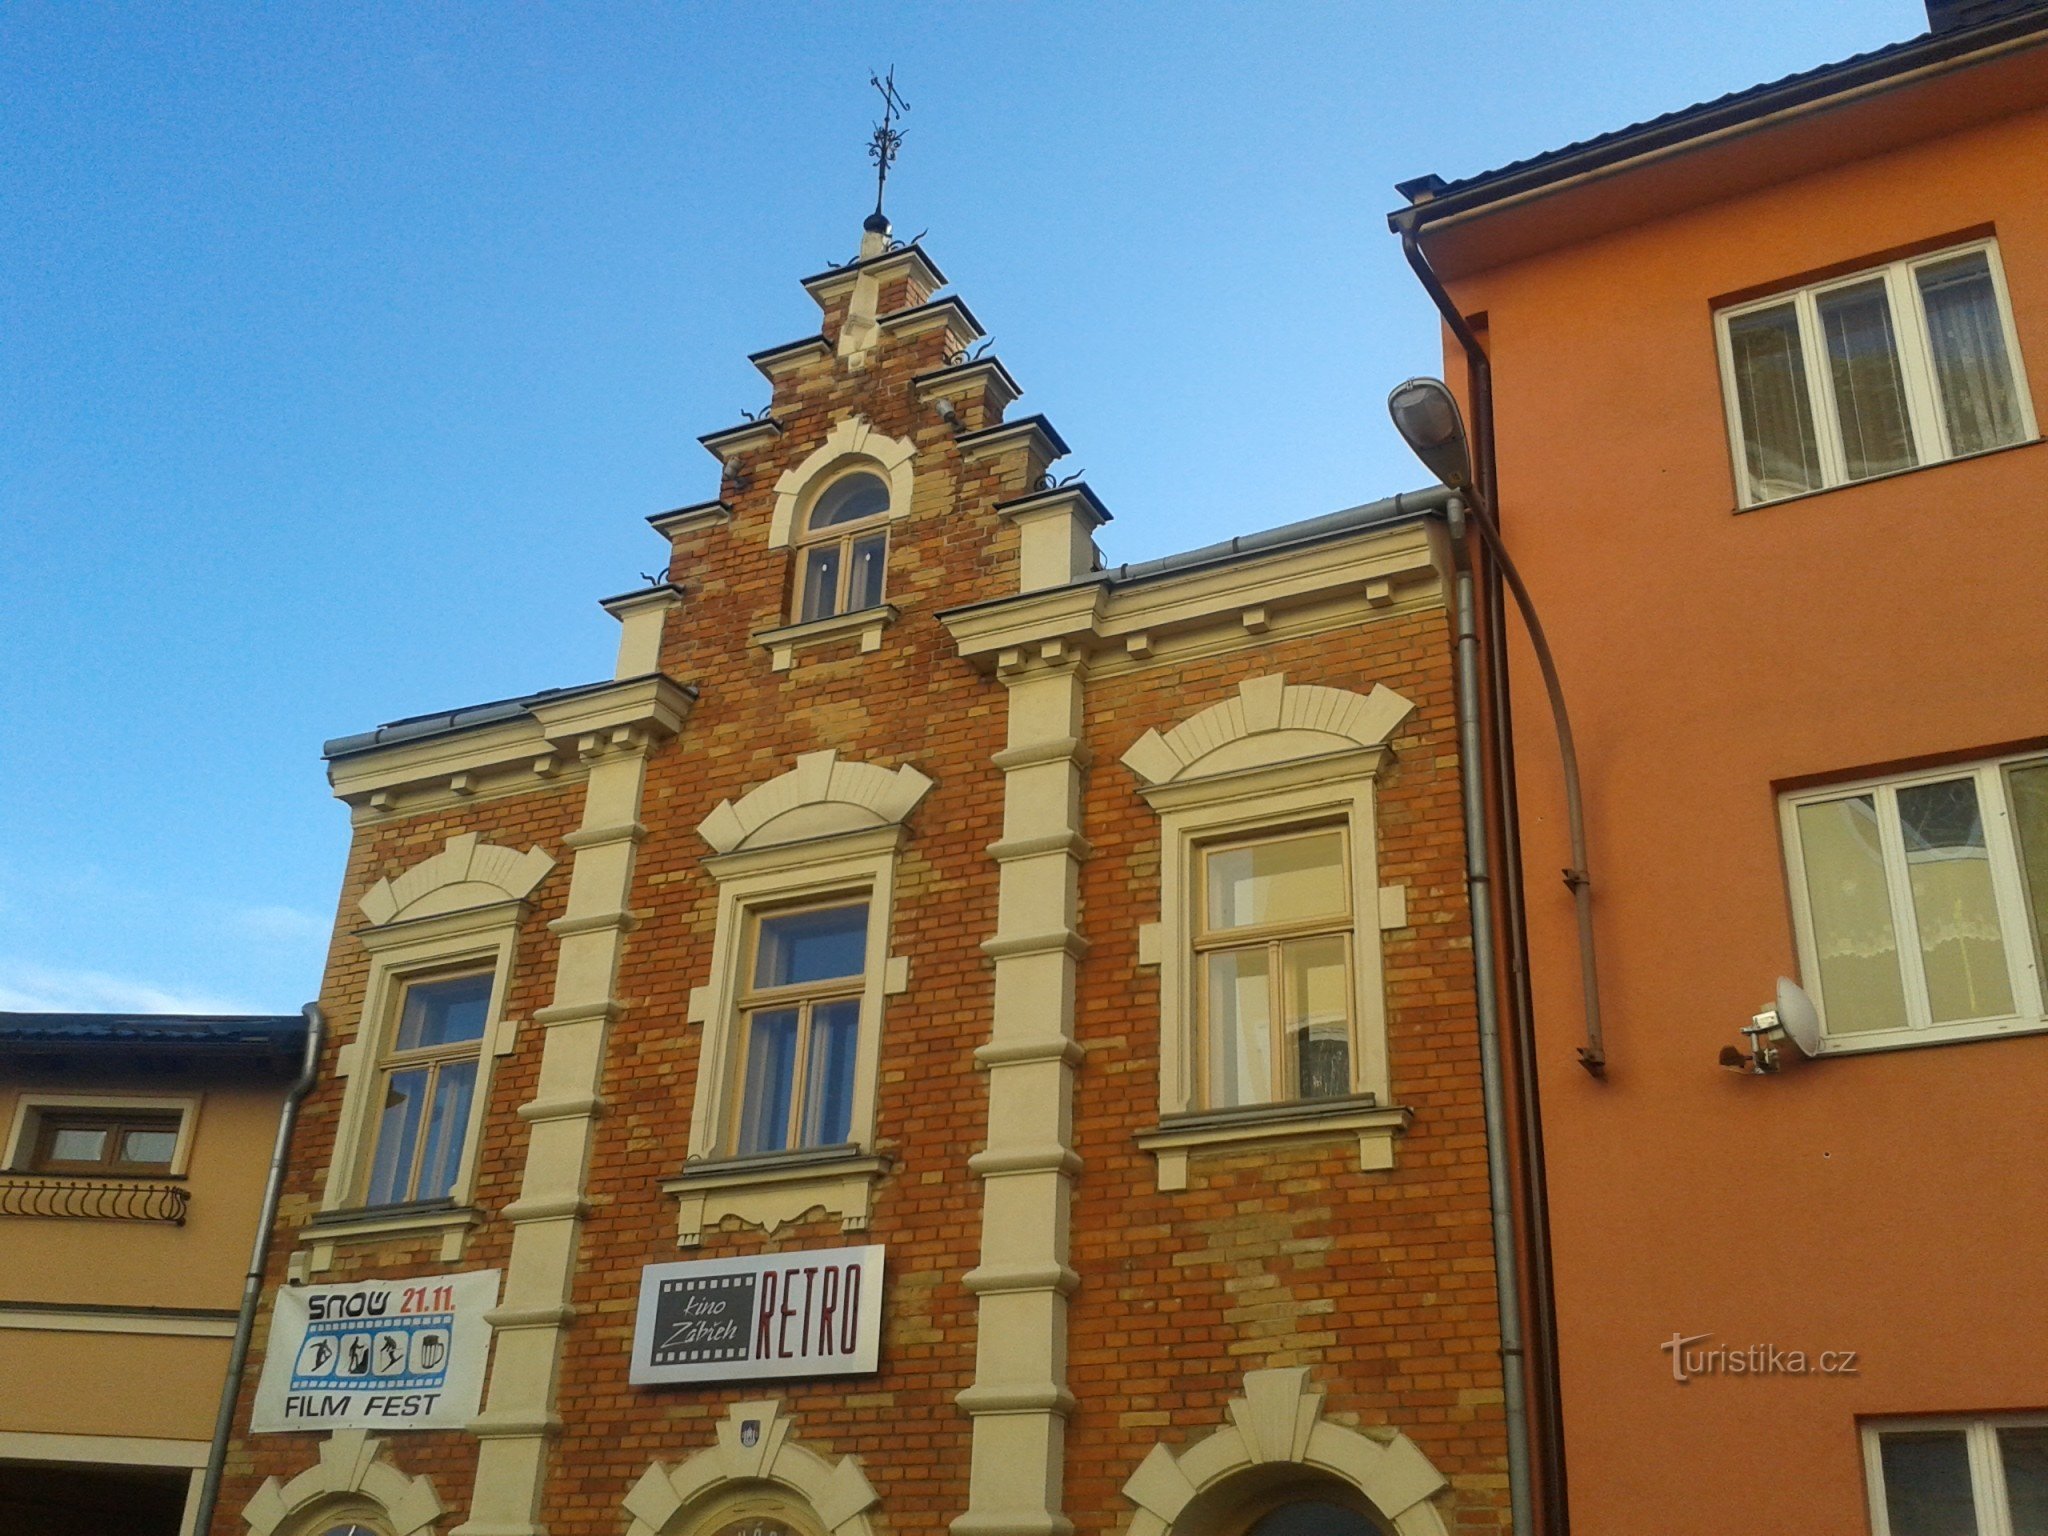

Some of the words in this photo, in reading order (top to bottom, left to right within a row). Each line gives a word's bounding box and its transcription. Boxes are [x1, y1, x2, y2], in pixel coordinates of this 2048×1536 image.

[399, 1285, 456, 1314] 21.11.
[683, 1295, 727, 1317] kino
[755, 1263, 861, 1360] RETRO
[660, 1318, 738, 1349] Zábřeh
[284, 1396, 352, 1418] FILM
[363, 1394, 441, 1416] FEST
